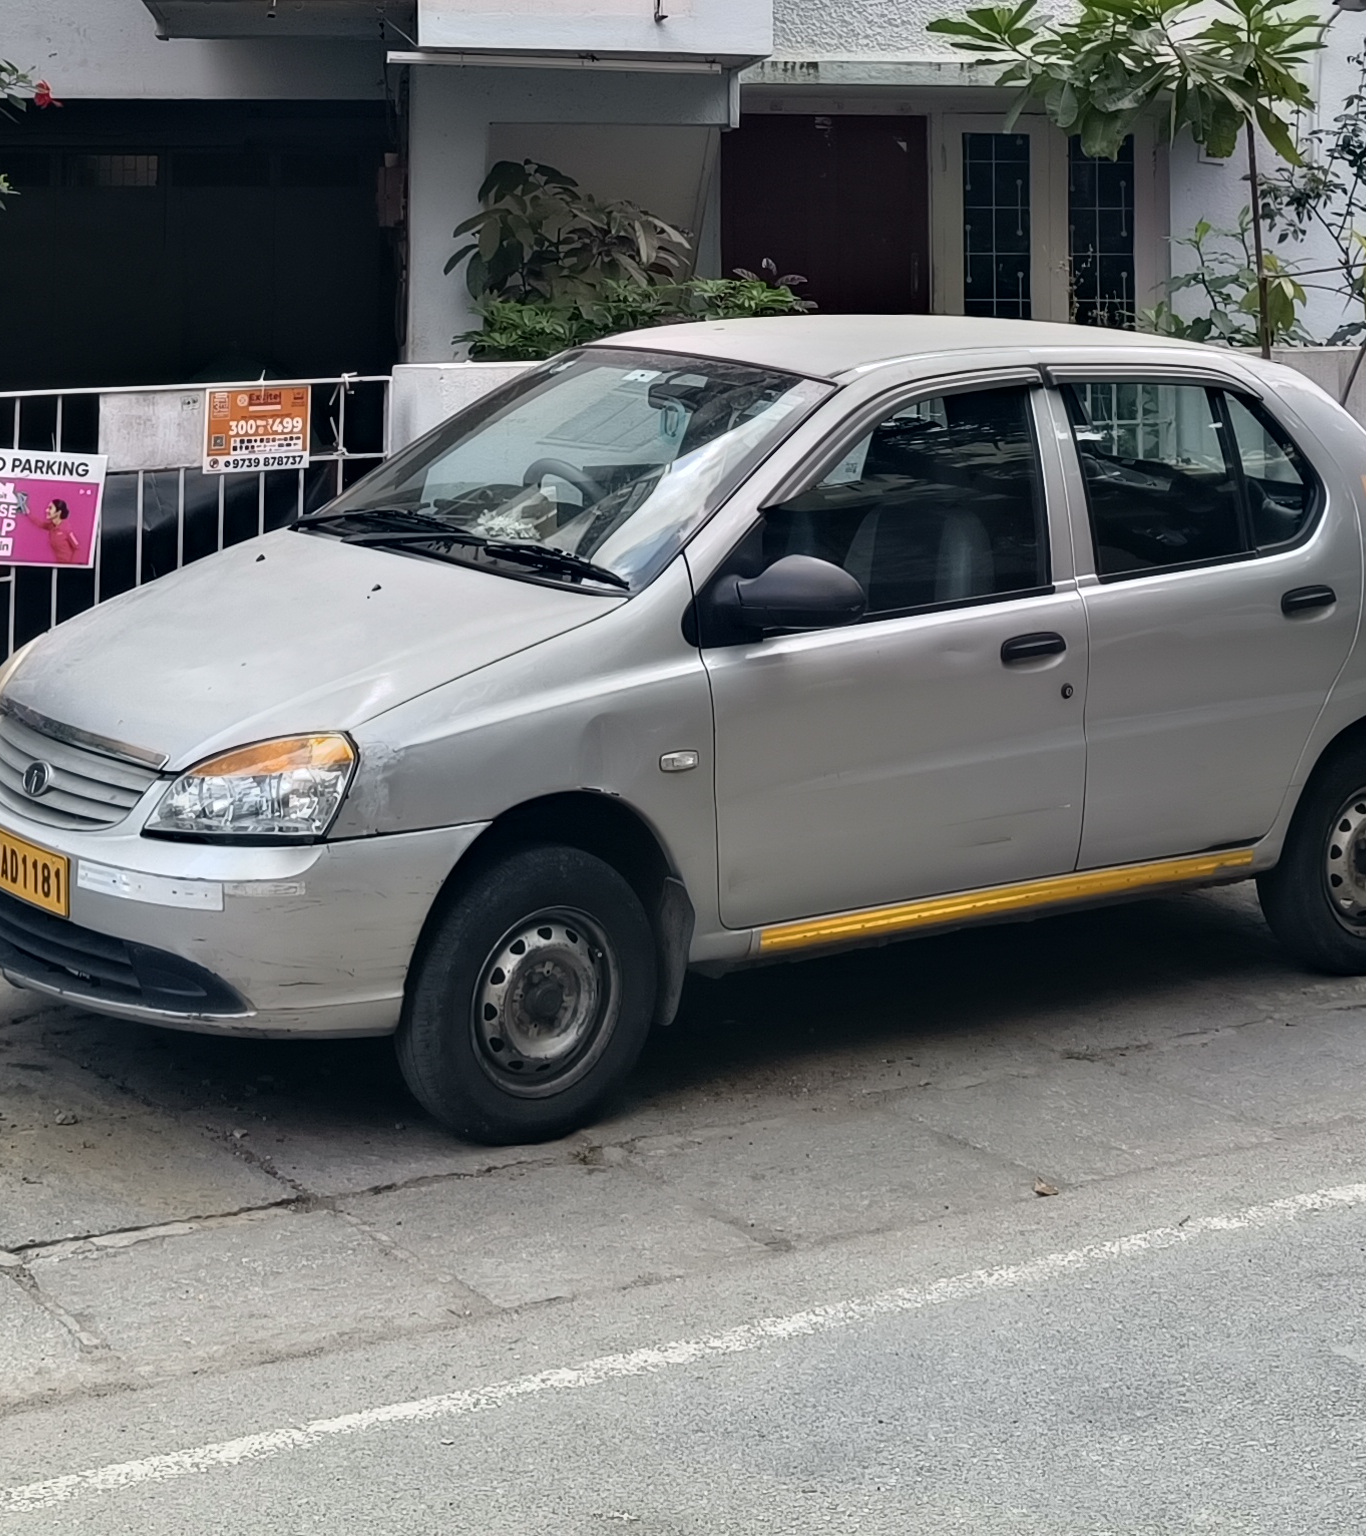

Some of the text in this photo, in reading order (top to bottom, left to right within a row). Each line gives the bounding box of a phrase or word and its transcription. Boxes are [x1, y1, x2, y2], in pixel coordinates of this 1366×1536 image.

[229, 420, 256, 435] 300
[11, 458, 89, 477] PARKING
[232, 455, 303, 468] 9739 878737
